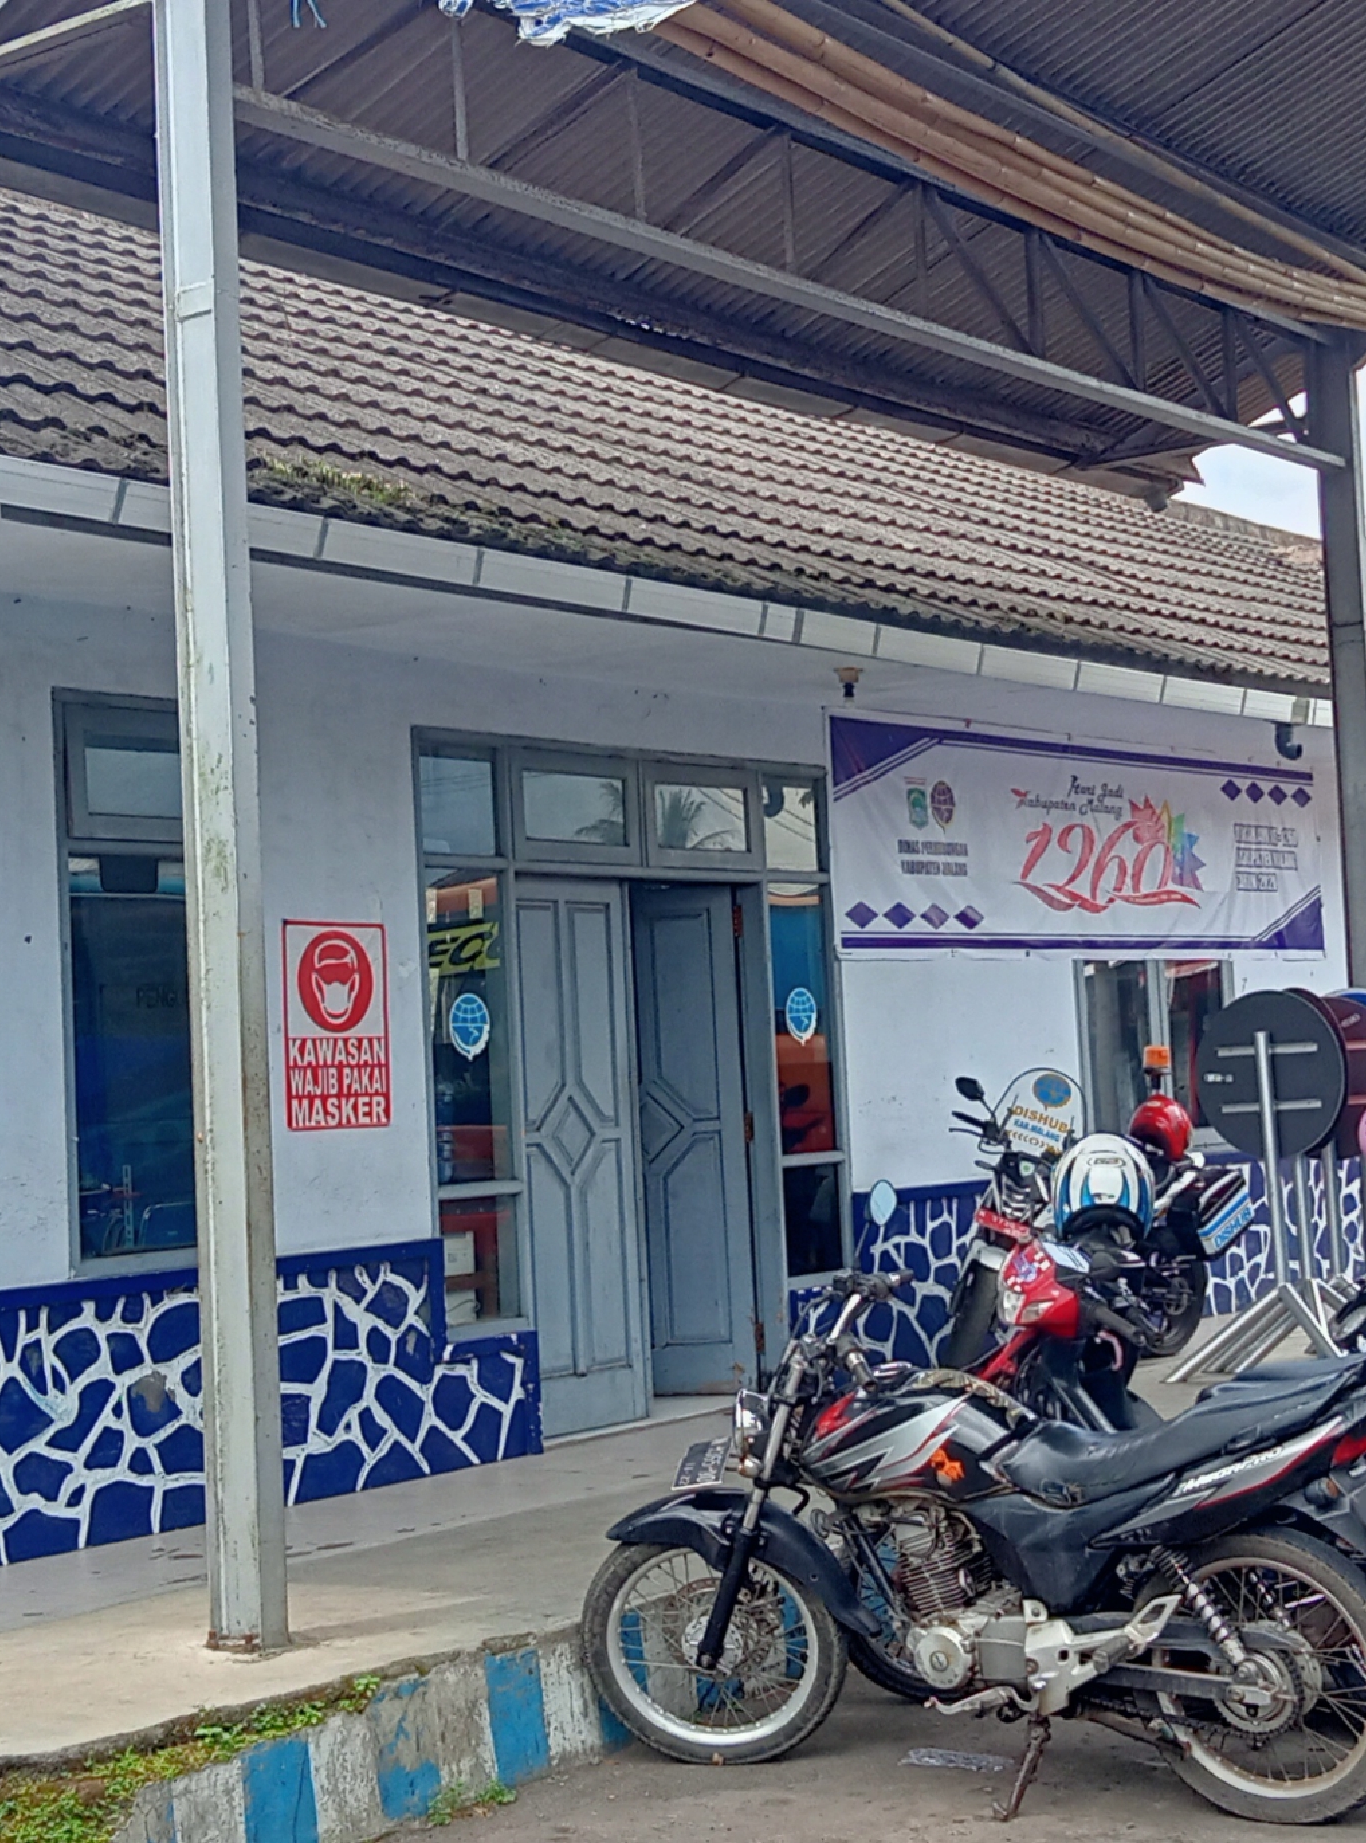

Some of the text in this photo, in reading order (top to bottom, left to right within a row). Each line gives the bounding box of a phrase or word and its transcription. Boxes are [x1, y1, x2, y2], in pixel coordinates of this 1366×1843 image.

[1021, 818, 1173, 905] 1260
[288, 1037, 385, 1067] KAWASAN
[290, 1066, 386, 1096] WAJIB PAKAI
[291, 1096, 387, 1128] MASKER
